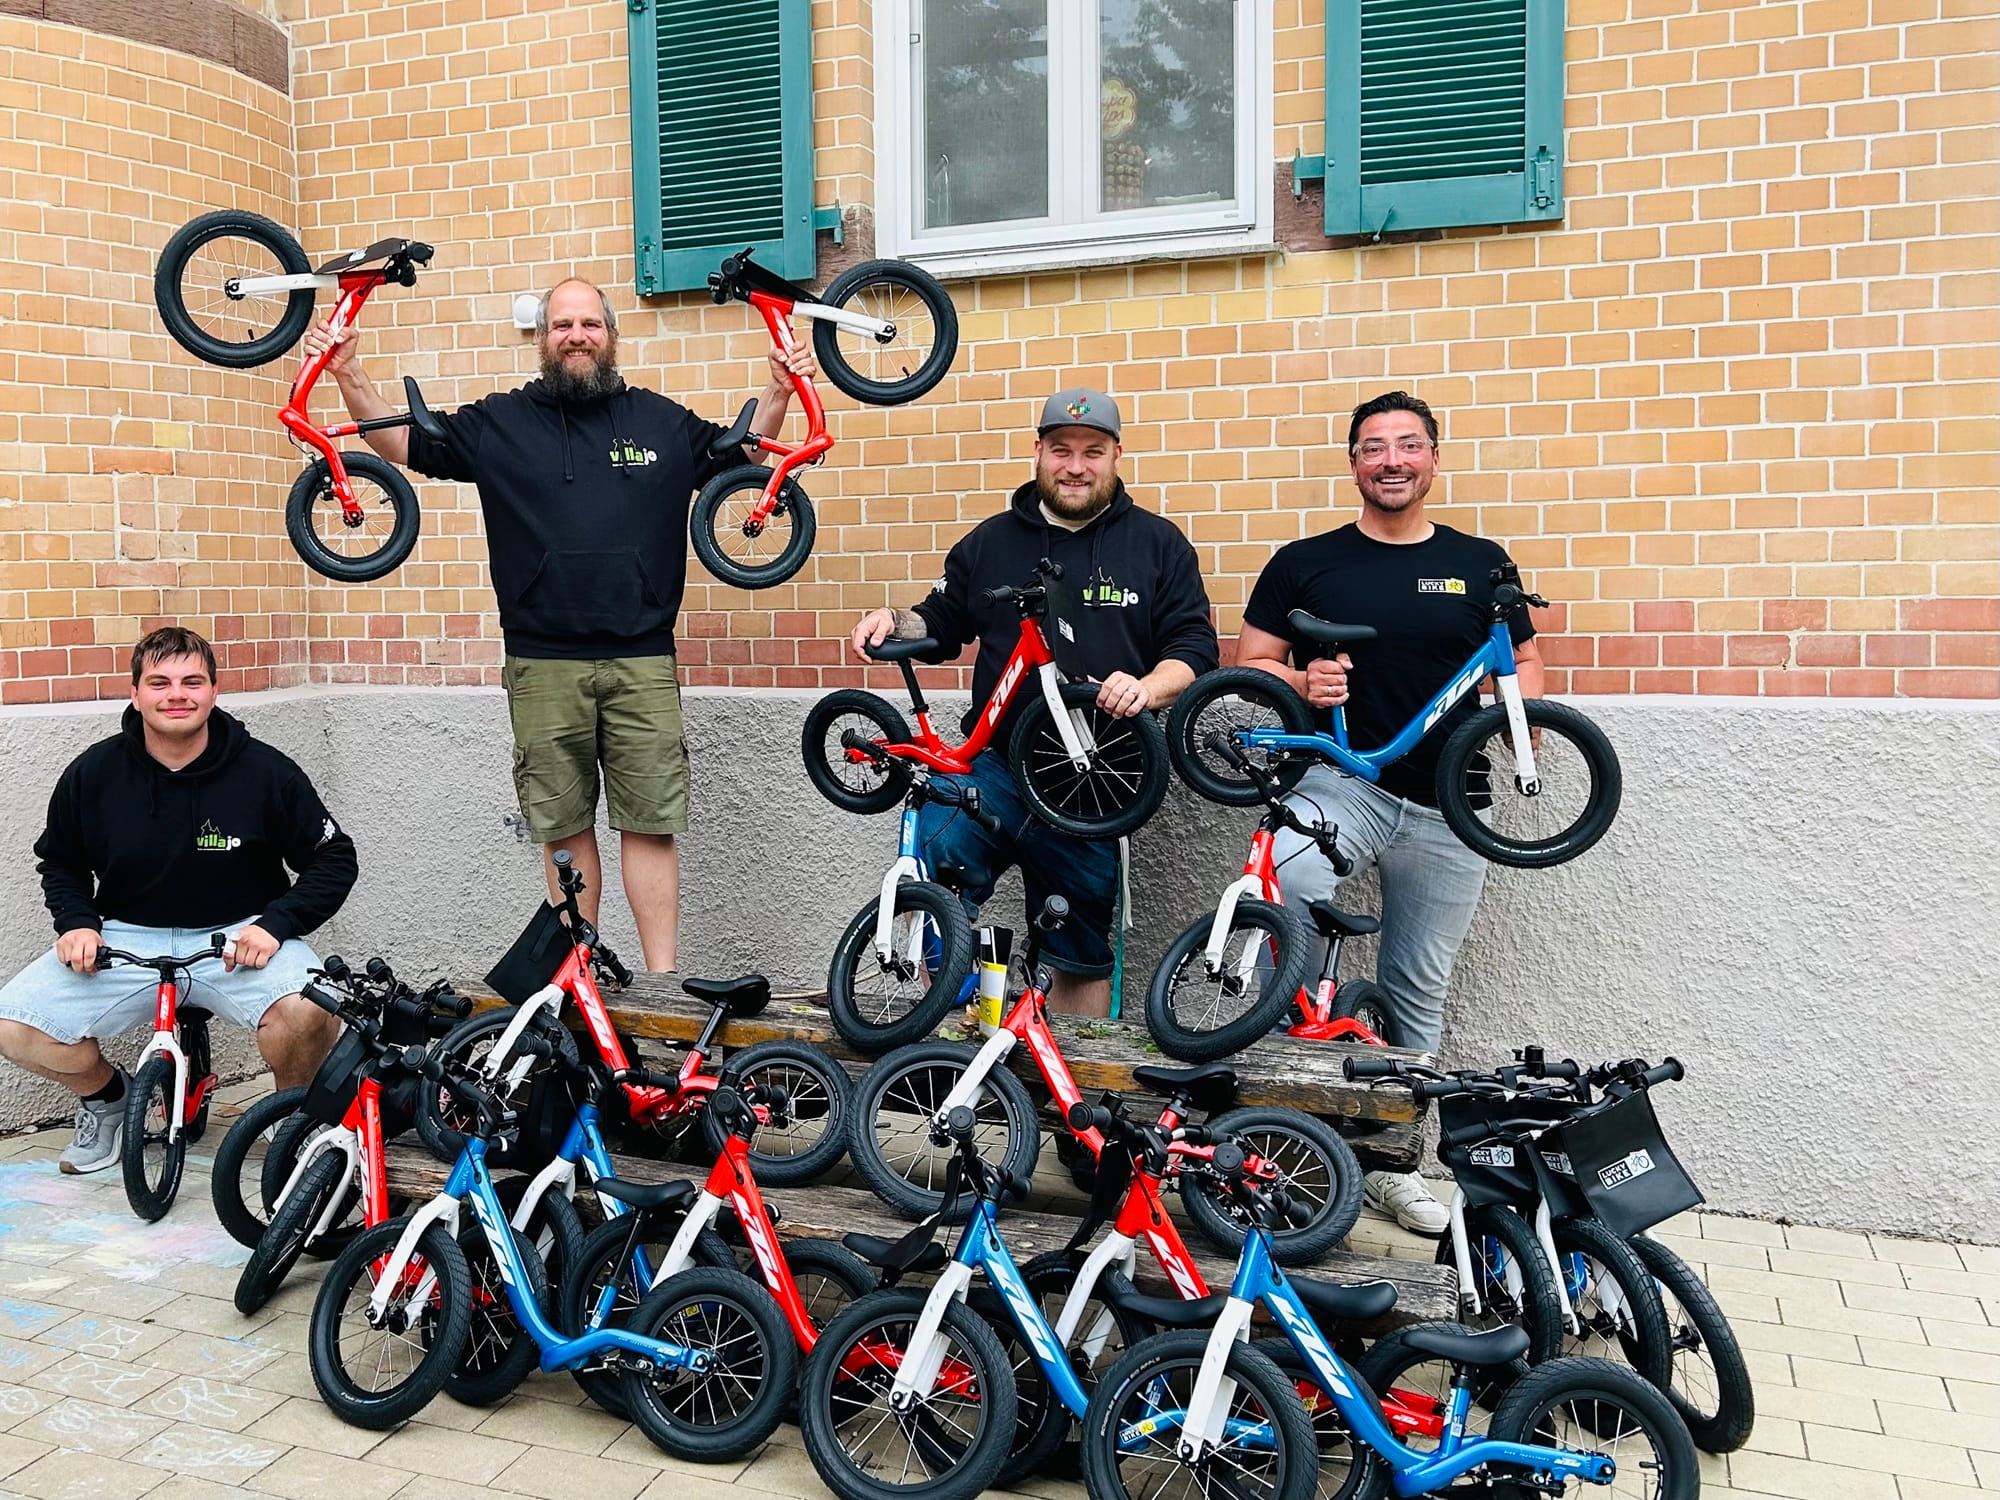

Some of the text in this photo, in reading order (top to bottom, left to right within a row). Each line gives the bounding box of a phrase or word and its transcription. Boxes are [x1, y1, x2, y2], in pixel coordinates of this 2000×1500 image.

[609, 447, 658, 465] vllajo
[1082, 585, 1139, 607] vllajo
[1423, 662, 1484, 734] KTM
[196, 834, 241, 851] villajo
[1601, 1162, 1626, 1179] LUCKY
[1604, 1168, 1631, 1186] BIKE
[469, 1189, 516, 1287] KTM
[732, 1189, 782, 1293] KTM
[985, 1258, 1056, 1364] KTM
[1267, 1292, 1354, 1399] KTM
